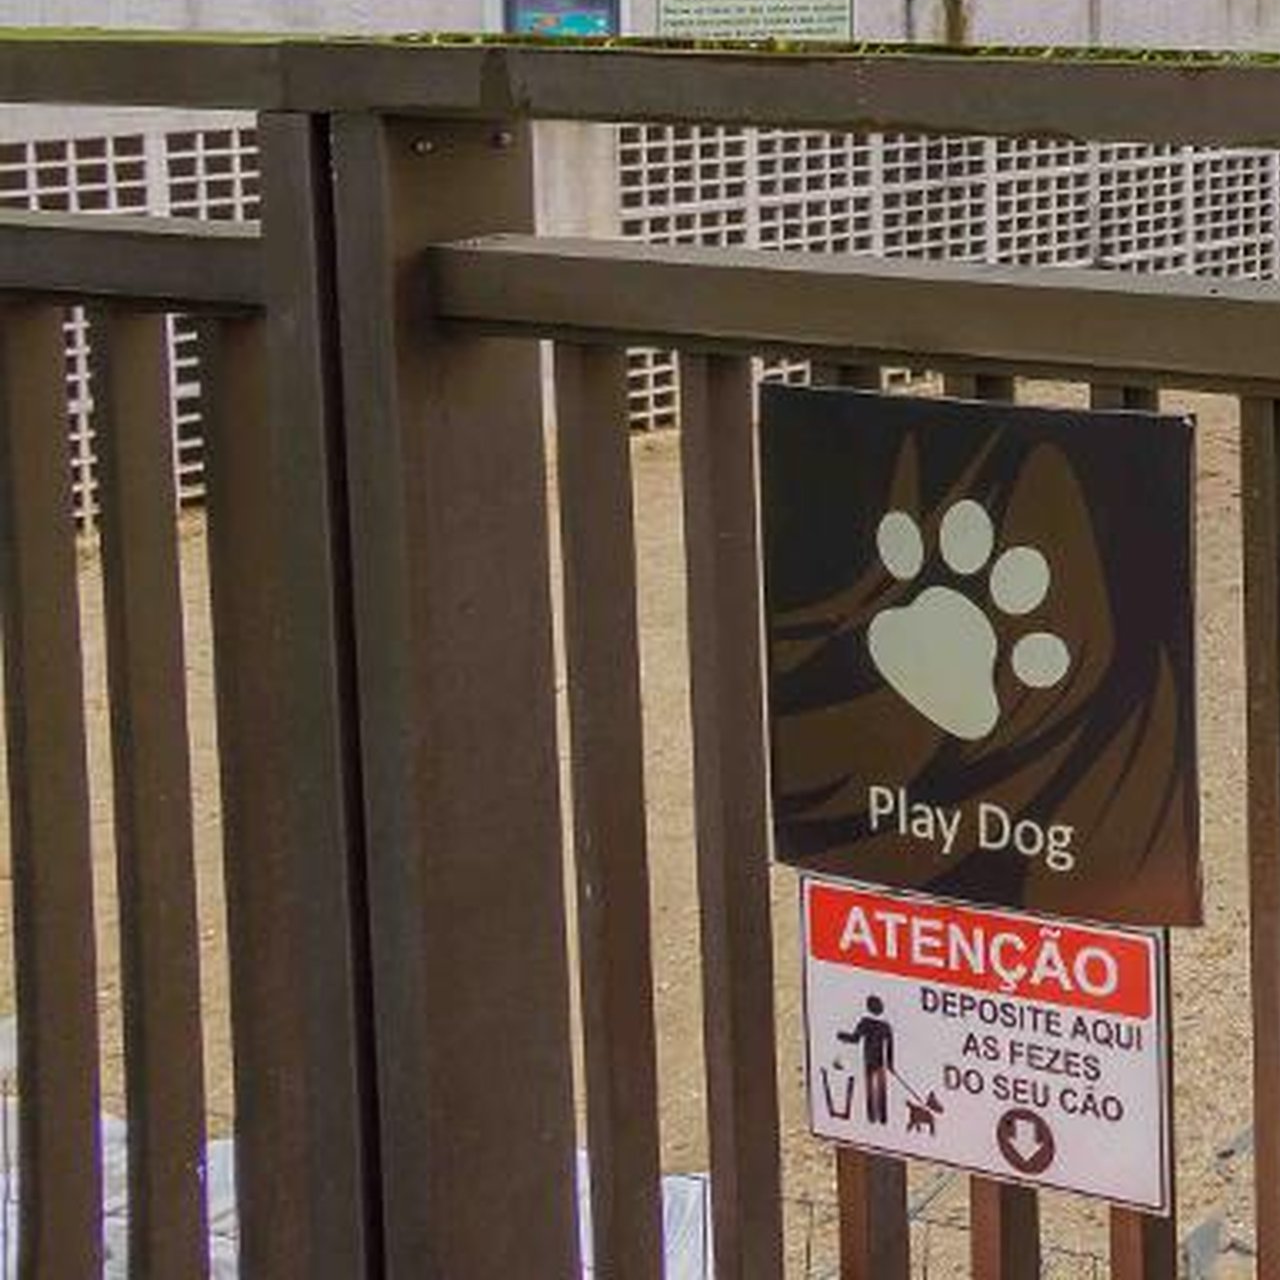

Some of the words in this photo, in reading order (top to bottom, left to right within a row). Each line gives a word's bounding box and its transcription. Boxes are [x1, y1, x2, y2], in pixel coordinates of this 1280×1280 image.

[868, 784, 962, 855] Play
[977, 802, 1075, 871] Dog
[838, 906, 1119, 997] ATENÇÃO
[920, 986, 1063, 1038] DEPOSITE
[1070, 1016, 1143, 1052] AQUI
[961, 1032, 1001, 1062] AS
[1008, 1039, 1103, 1083] FEZES
[943, 1064, 985, 1095] DO
[991, 1074, 1051, 1110] SEU
[1058, 1084, 1125, 1122] CÃO
